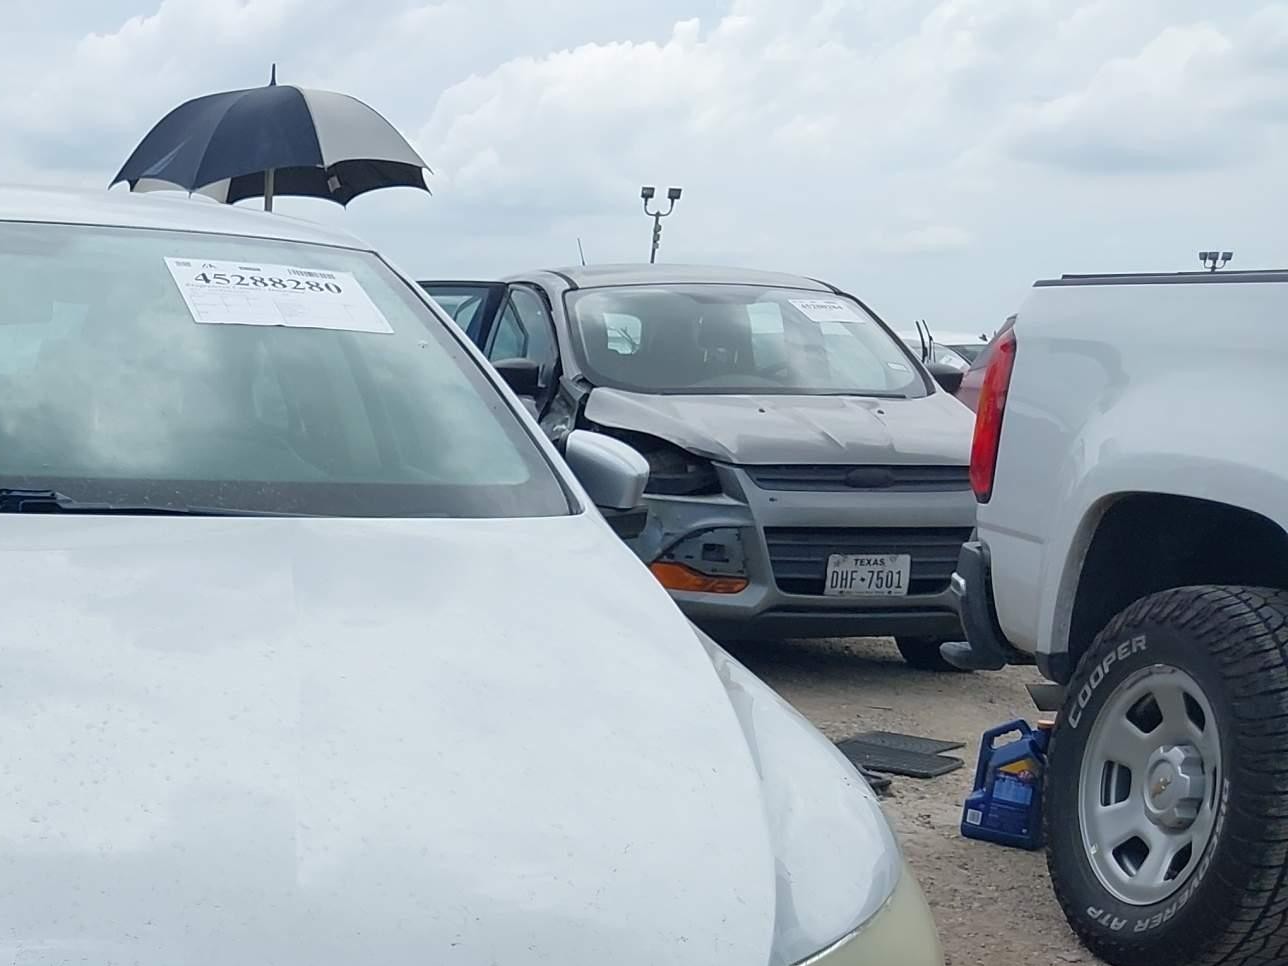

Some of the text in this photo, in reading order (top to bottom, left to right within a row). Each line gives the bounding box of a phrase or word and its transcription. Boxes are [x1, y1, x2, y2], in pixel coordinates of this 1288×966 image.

[194, 272, 343, 294] 45288280
[854, 558, 886, 566] TEXAS
[1068, 635, 1147, 729] COOPER
[1086, 906, 1128, 931] ATP
